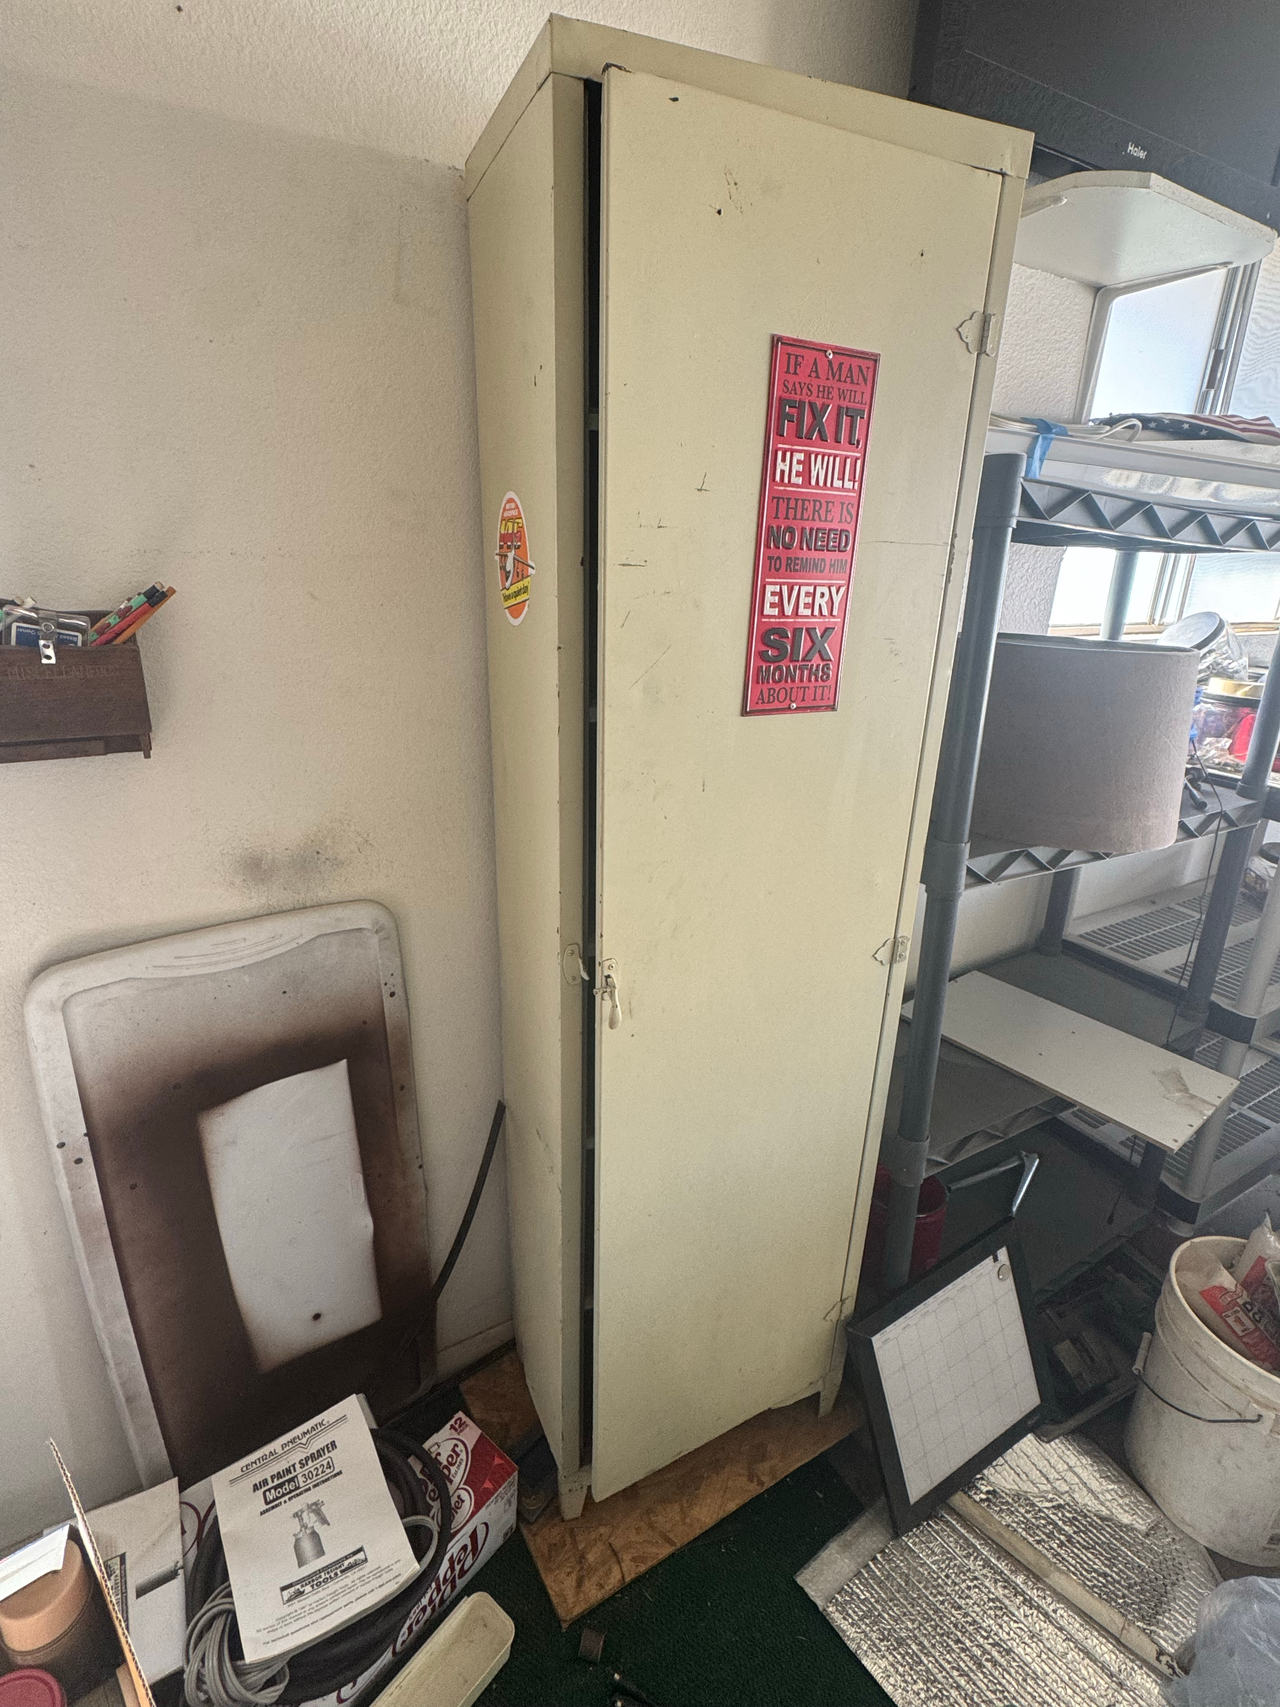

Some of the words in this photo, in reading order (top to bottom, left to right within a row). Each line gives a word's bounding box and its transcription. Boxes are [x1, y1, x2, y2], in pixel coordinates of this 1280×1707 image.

[1127, 142, 1148, 160] Haier
[784, 352, 805, 376] IF
[808, 357, 821, 380] A
[825, 360, 871, 387] MAN
[782, 379, 814, 399] SAYS
[816, 382, 834, 401] HE
[837, 386, 867, 406] WILL
[776, 397, 833, 443] FIX
[774, 450, 805, 485] HE
[809, 453, 861, 490] WILL!
[771, 496, 835, 523] THERE
[838, 500, 855, 525] IS
[766, 525, 798, 550] NO
[801, 527, 851, 552] NEED
[767, 555, 782, 573] TO
[785, 556, 826, 574] REMIND
[828, 558, 848, 574] HIM
[762, 584, 847, 617] EVERY
[759, 626, 836, 663] SIX
[756, 663, 833, 684] MONTHS
[755, 685, 811, 705] ABOUT
[813, 684, 832, 702] IT!
[449, 1416, 464, 1434] 12
[240, 1447, 279, 1474] CENTRAL
[281, 1419, 327, 1450] PNEUMATIC
[252, 1476, 271, 1494] AIR
[269, 1463, 298, 1486] PAINT
[298, 1440, 338, 1470] SPRAYER
[265, 1481, 299, 1503] Model
[301, 1462, 333, 1485] 30224
[309, 1570, 340, 1592] TOOLS
[400, 1522, 488, 1648] Pepper
